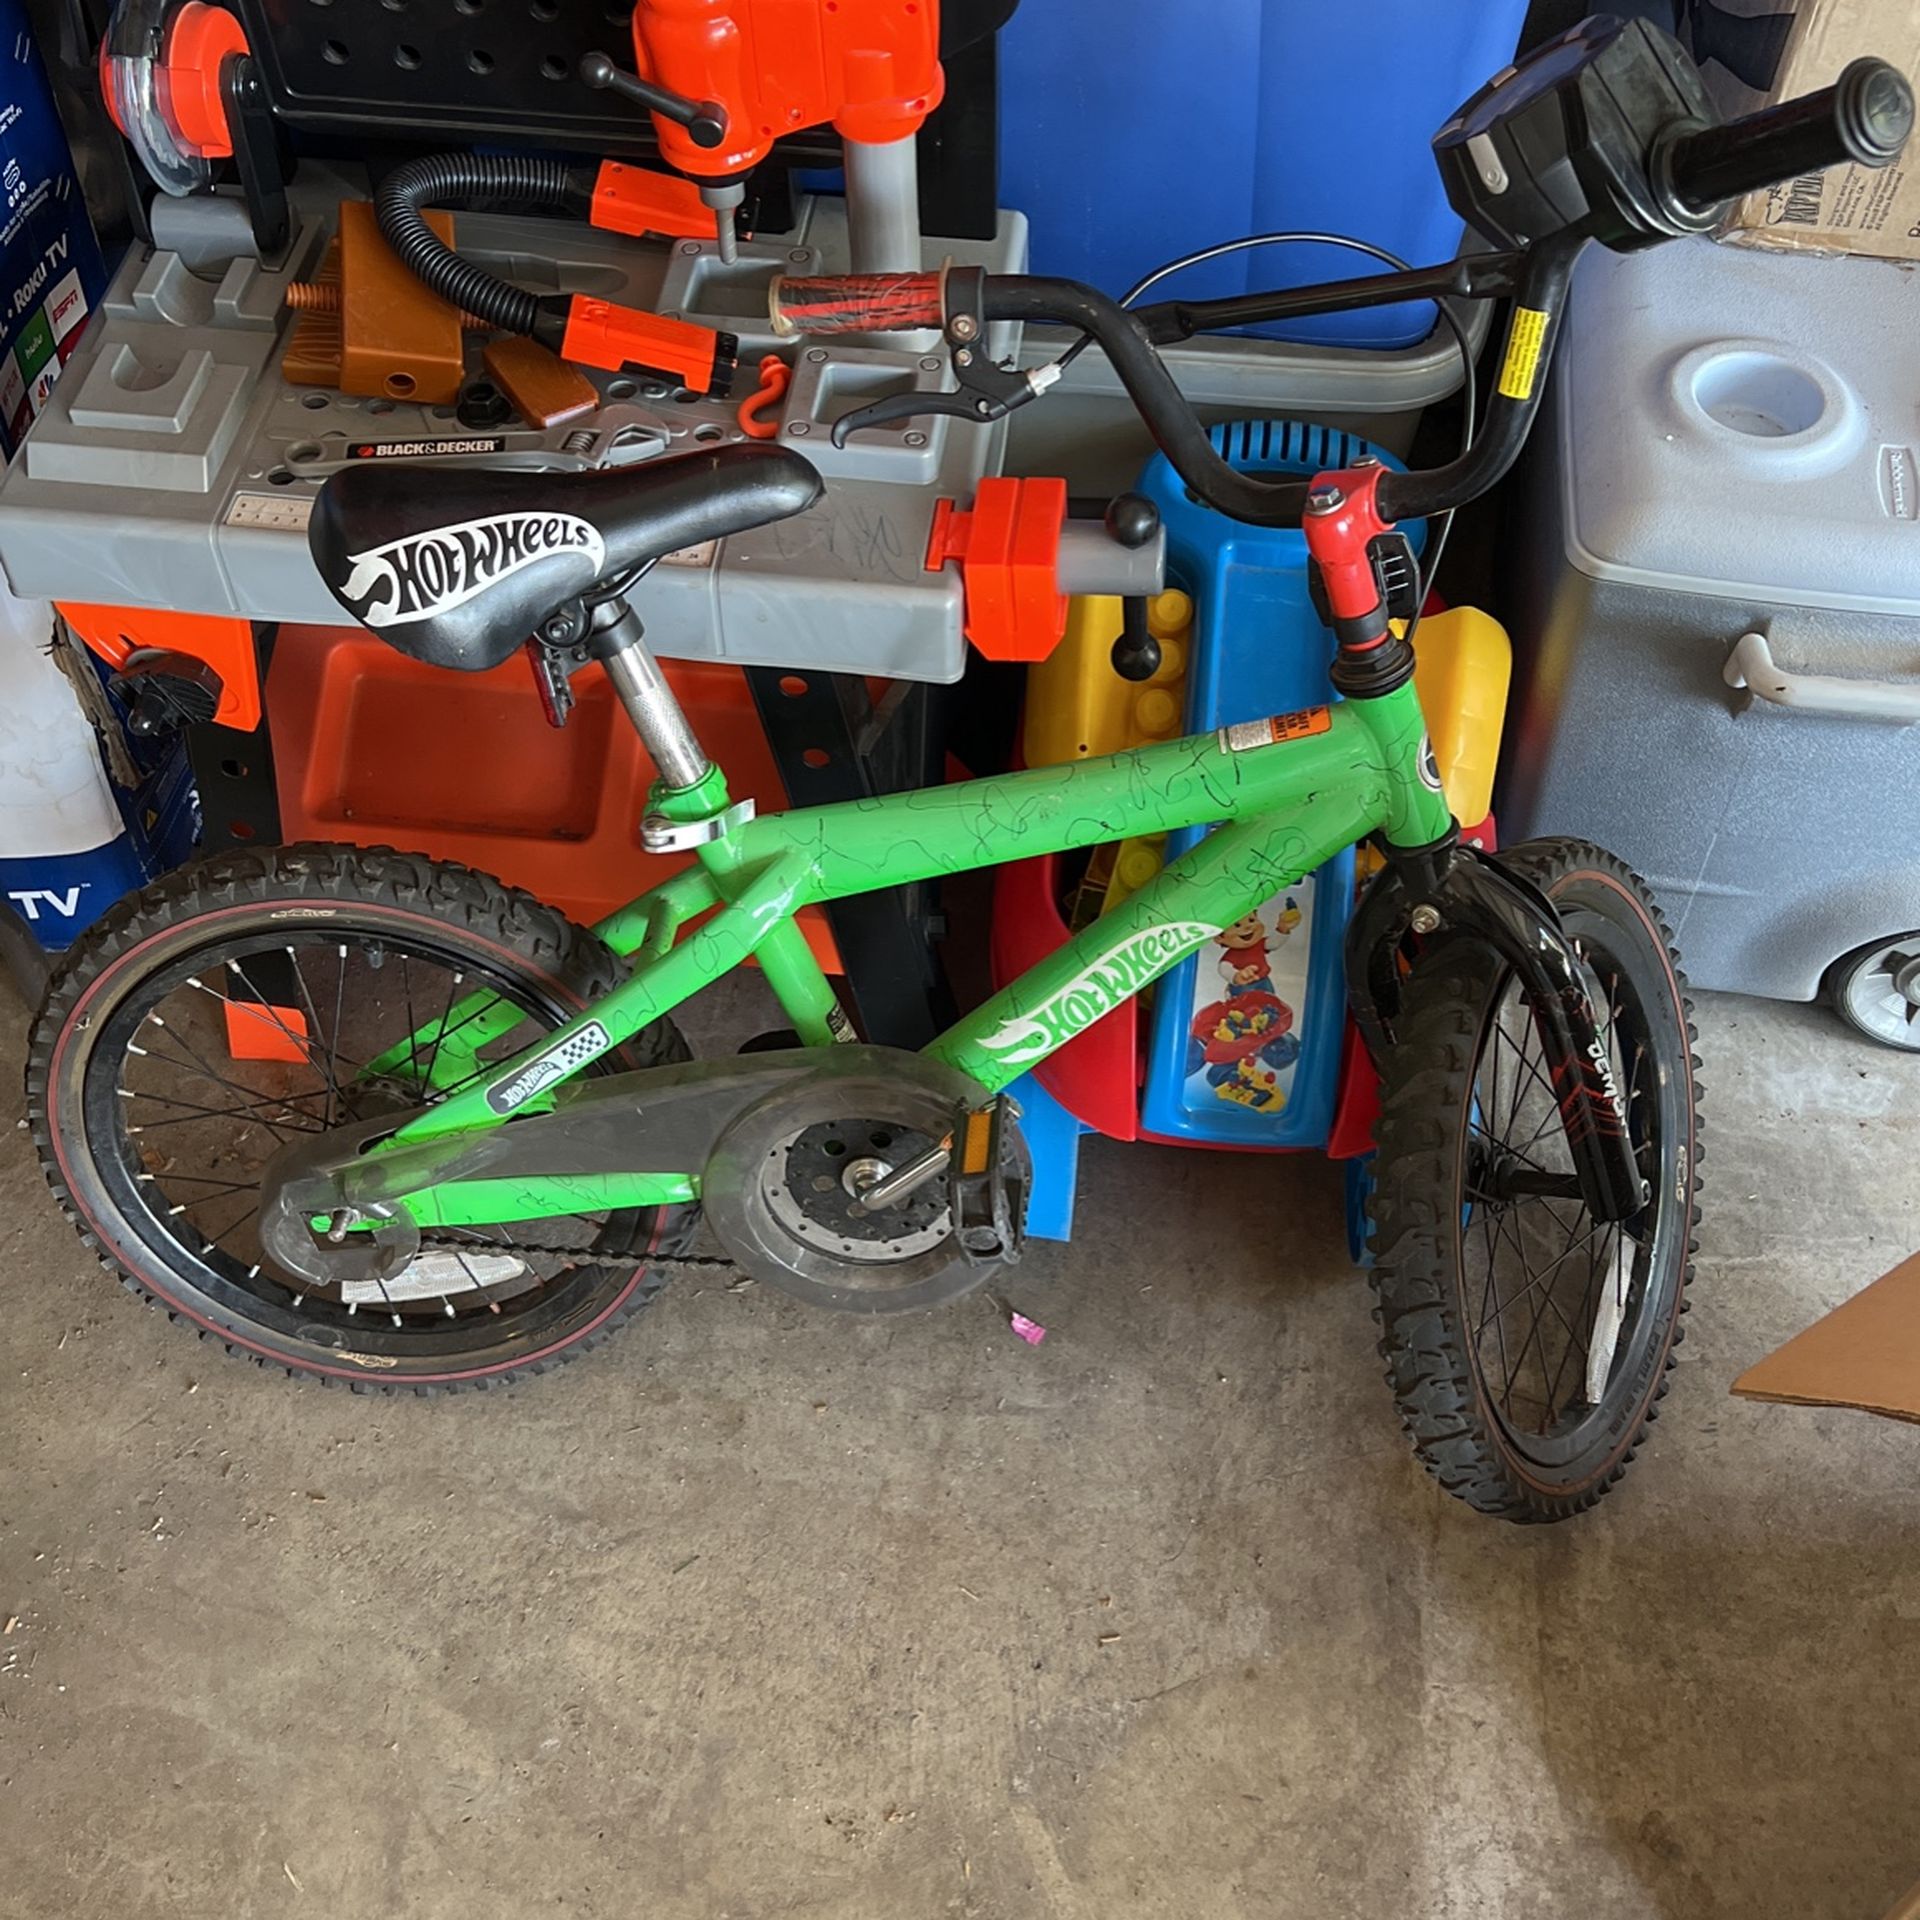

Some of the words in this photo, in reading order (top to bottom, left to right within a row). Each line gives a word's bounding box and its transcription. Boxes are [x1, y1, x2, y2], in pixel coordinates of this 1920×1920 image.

[45, 233, 68, 268] TV
[53, 289, 78, 323] ESPN
[376, 440, 495, 456] BLACK&DECKER
[8, 887, 80, 920] TV
